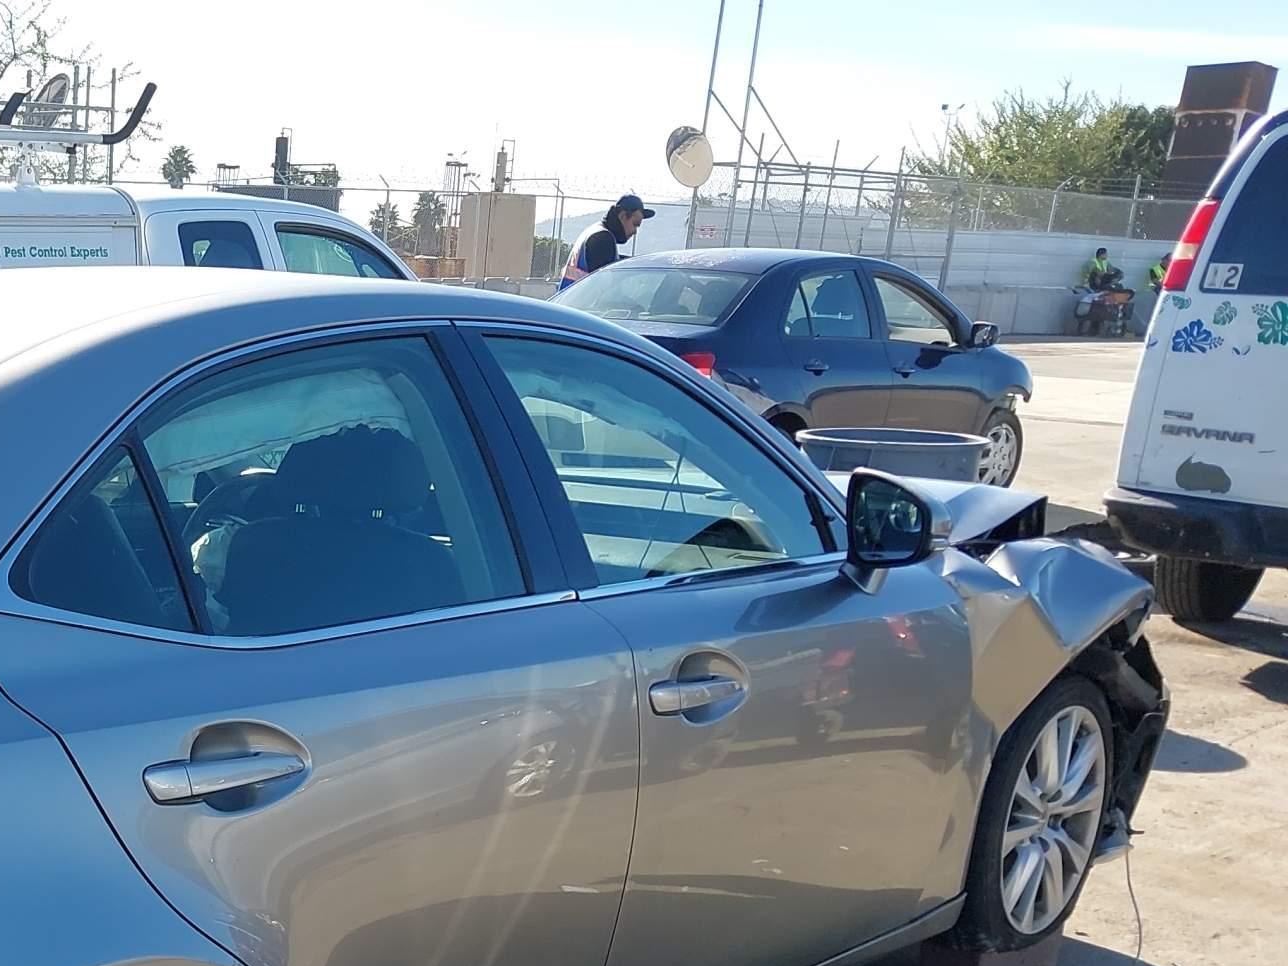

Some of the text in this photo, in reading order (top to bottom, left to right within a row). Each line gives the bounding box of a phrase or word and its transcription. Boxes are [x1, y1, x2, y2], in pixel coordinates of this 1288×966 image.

[4, 246, 26, 258] Pest
[29, 246, 67, 258] Control
[70, 246, 109, 259] Experts
[1161, 423, 1256, 444] SAVANA
